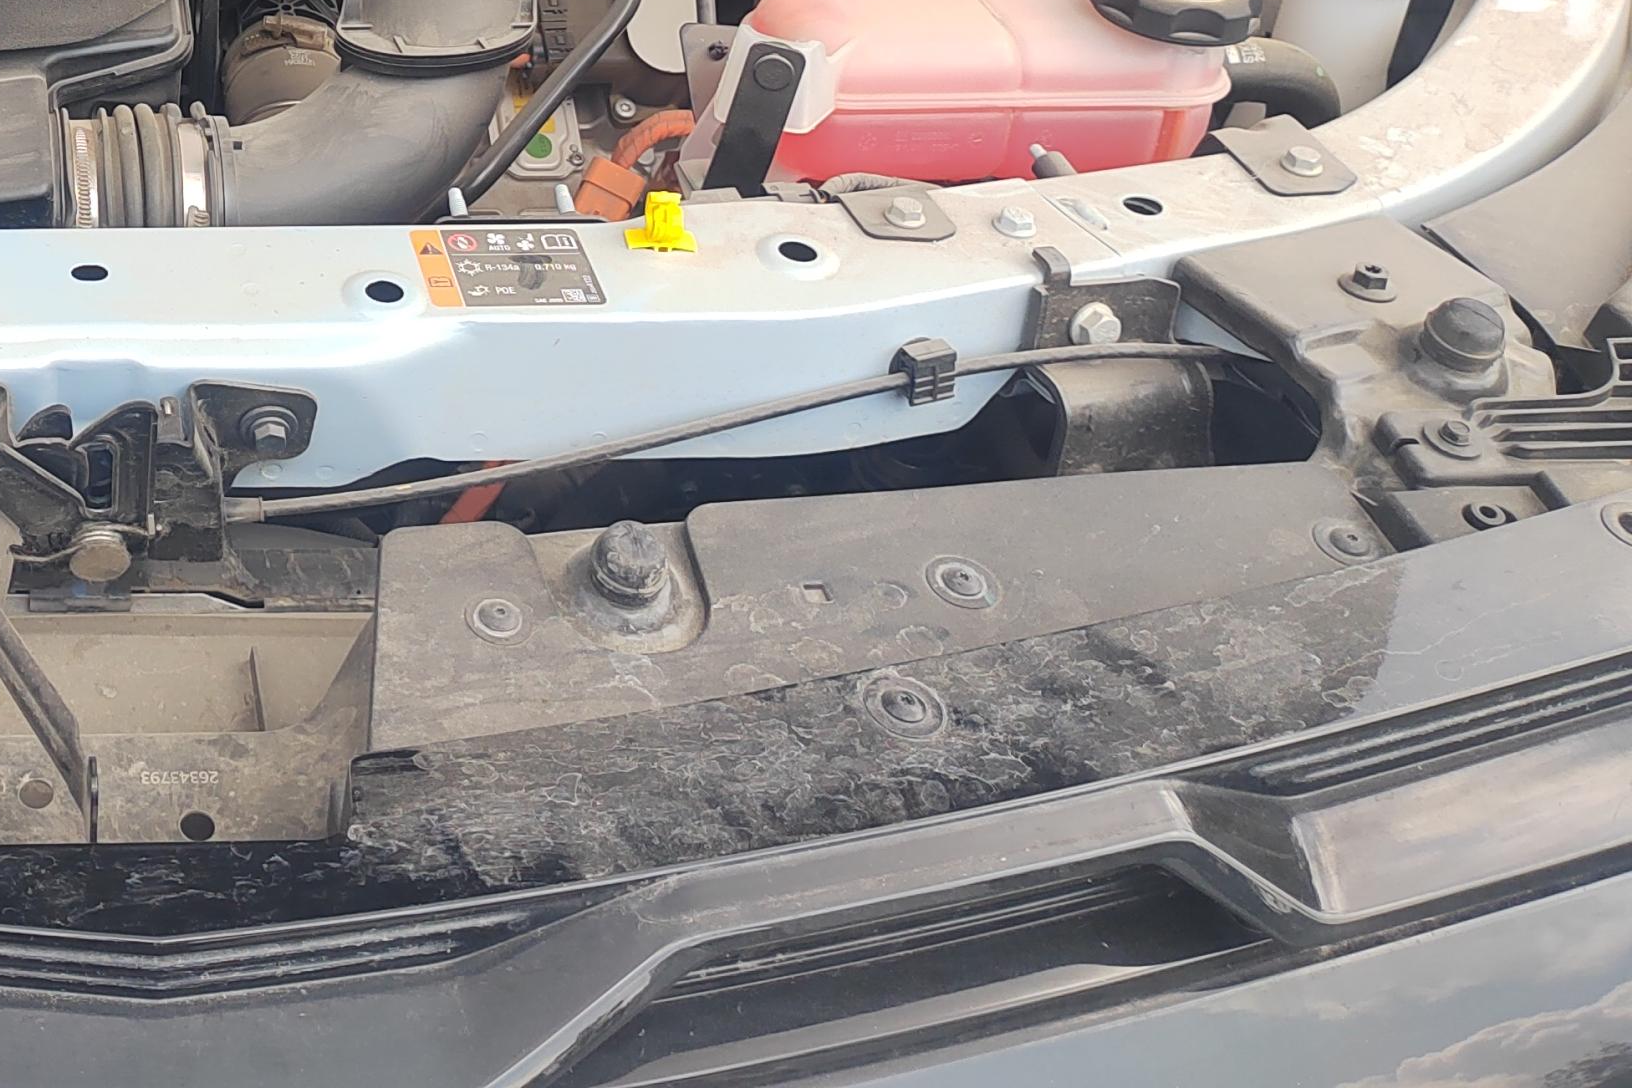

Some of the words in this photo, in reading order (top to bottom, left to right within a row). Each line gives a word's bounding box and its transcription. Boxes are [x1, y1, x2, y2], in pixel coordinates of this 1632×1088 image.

[485, 263, 520, 271] R-134a
[534, 263, 562, 271] 0.710
[495, 286, 517, 295] POE
[141, 770, 219, 784] 26343793
